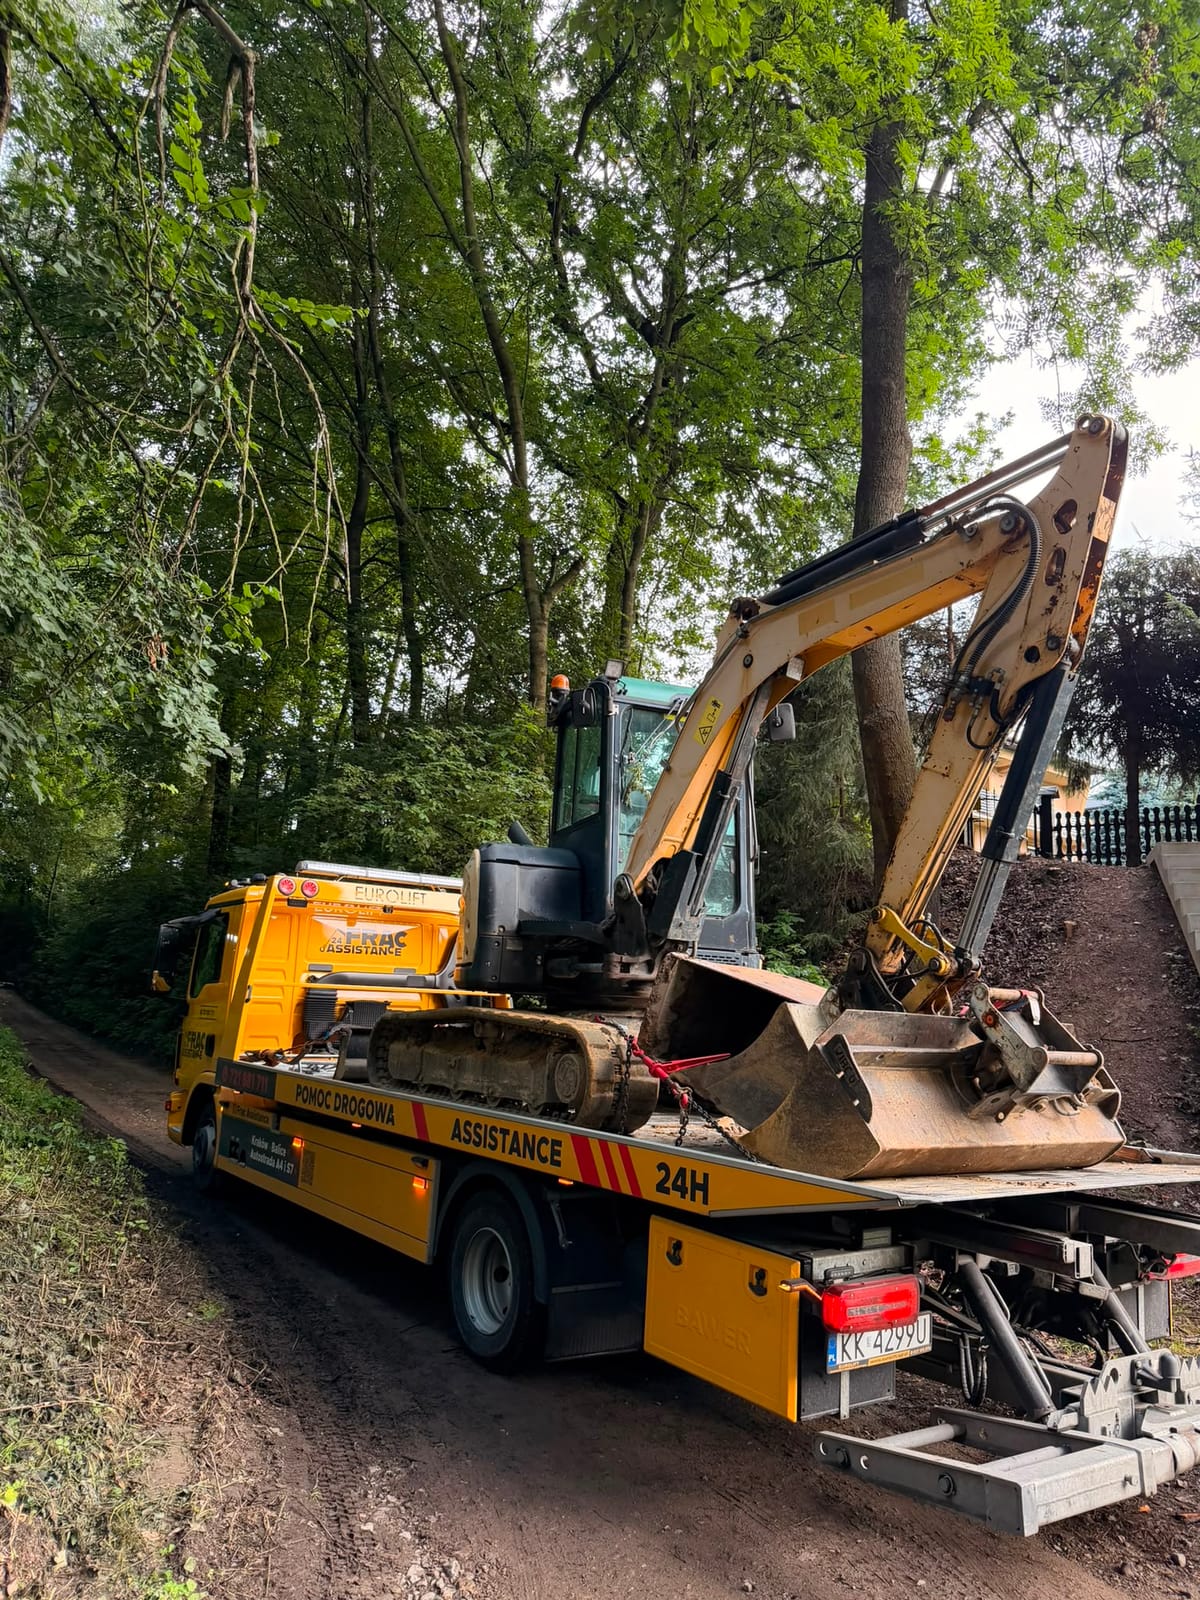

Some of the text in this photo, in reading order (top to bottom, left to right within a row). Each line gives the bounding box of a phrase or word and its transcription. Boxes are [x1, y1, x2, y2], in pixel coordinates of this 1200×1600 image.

[355, 886, 427, 905] EUROLIFT
[327, 944, 402, 957] ASSISTANCE
[346, 928, 408, 948] FRAC
[295, 1083, 395, 1126] POMOC DROGOWA
[250, 1148, 275, 1168] Autostrada
[450, 1118, 563, 1168] ASSISTANCE
[655, 1162, 710, 1206] 24H
[675, 1303, 752, 1355] BAWER
[841, 1332, 865, 1362] KK
[873, 1317, 927, 1354] 4299U
